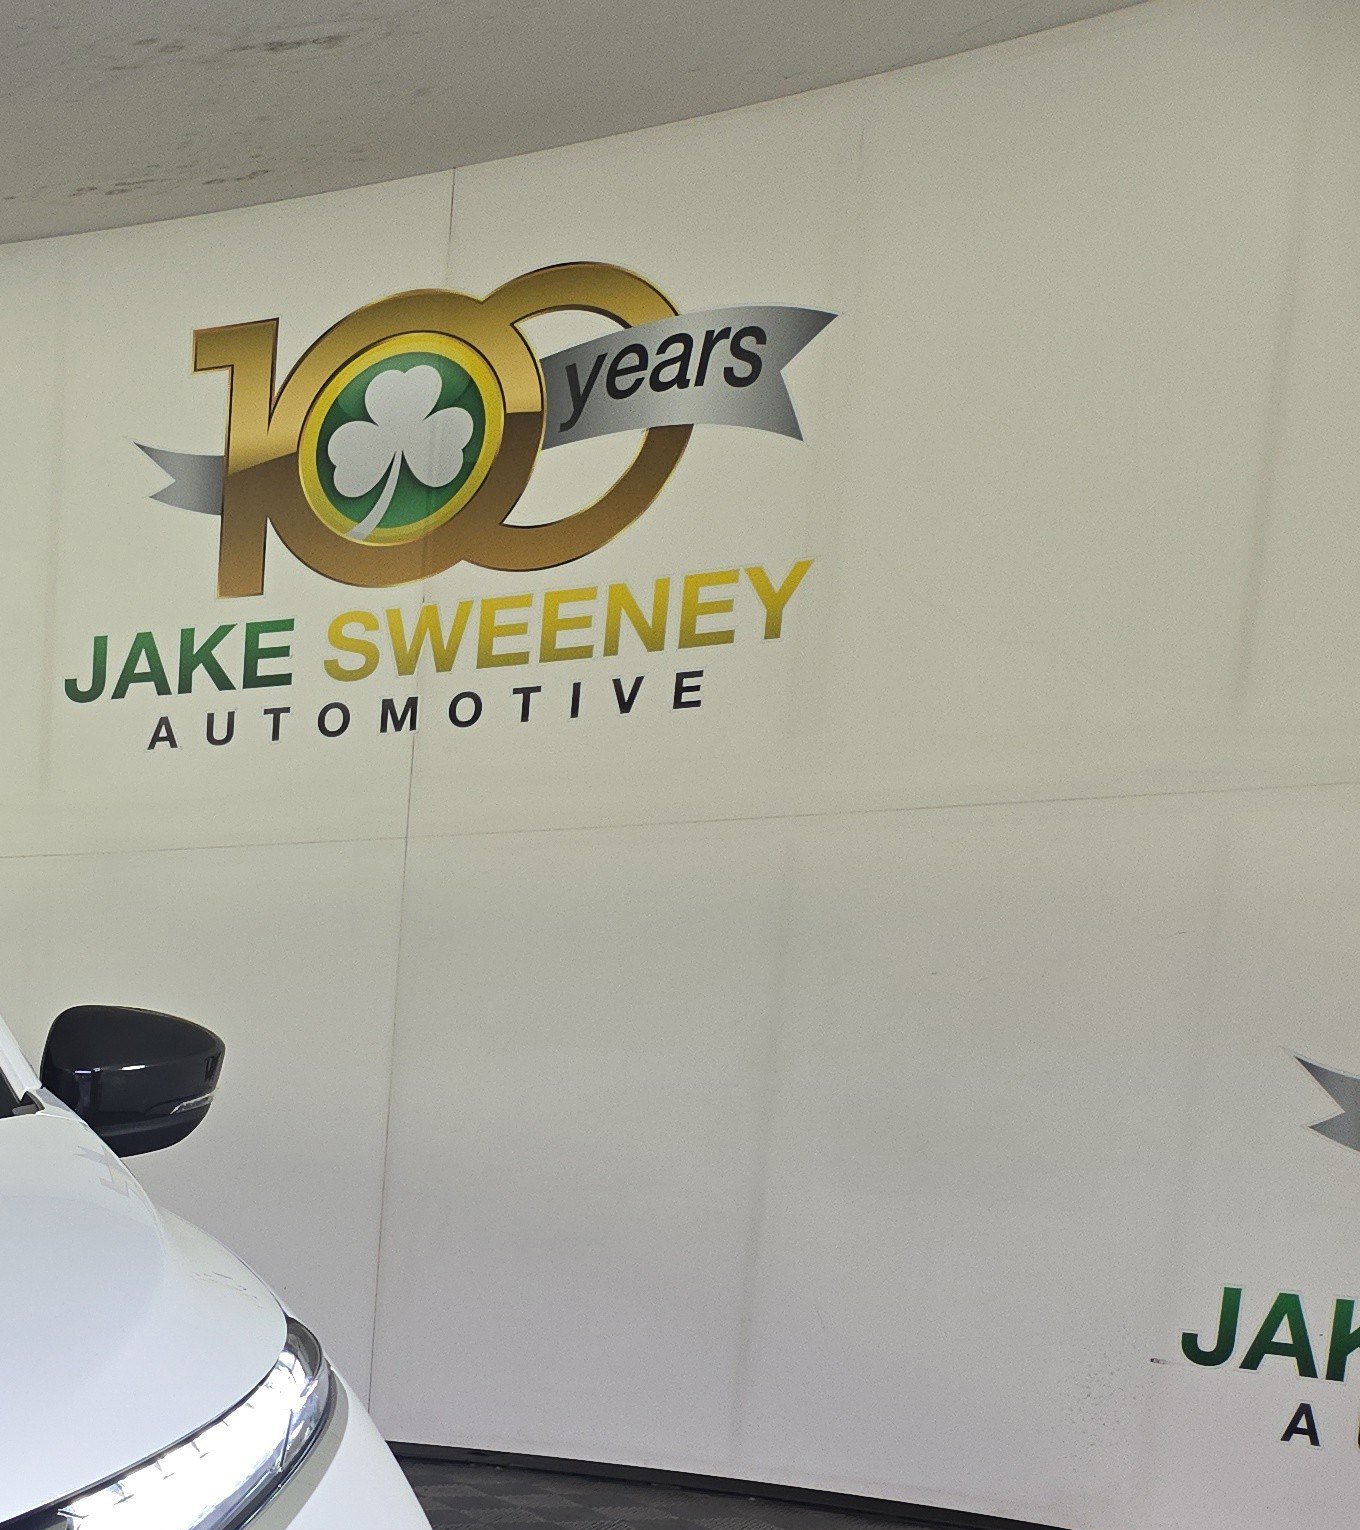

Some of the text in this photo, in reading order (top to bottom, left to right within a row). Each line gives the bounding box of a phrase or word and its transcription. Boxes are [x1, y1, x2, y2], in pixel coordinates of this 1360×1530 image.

[192, 260, 767, 600] 100 years
[64, 558, 815, 704] JAKE SWEENEY
[147, 670, 704, 751] AUTOMOTIVE
